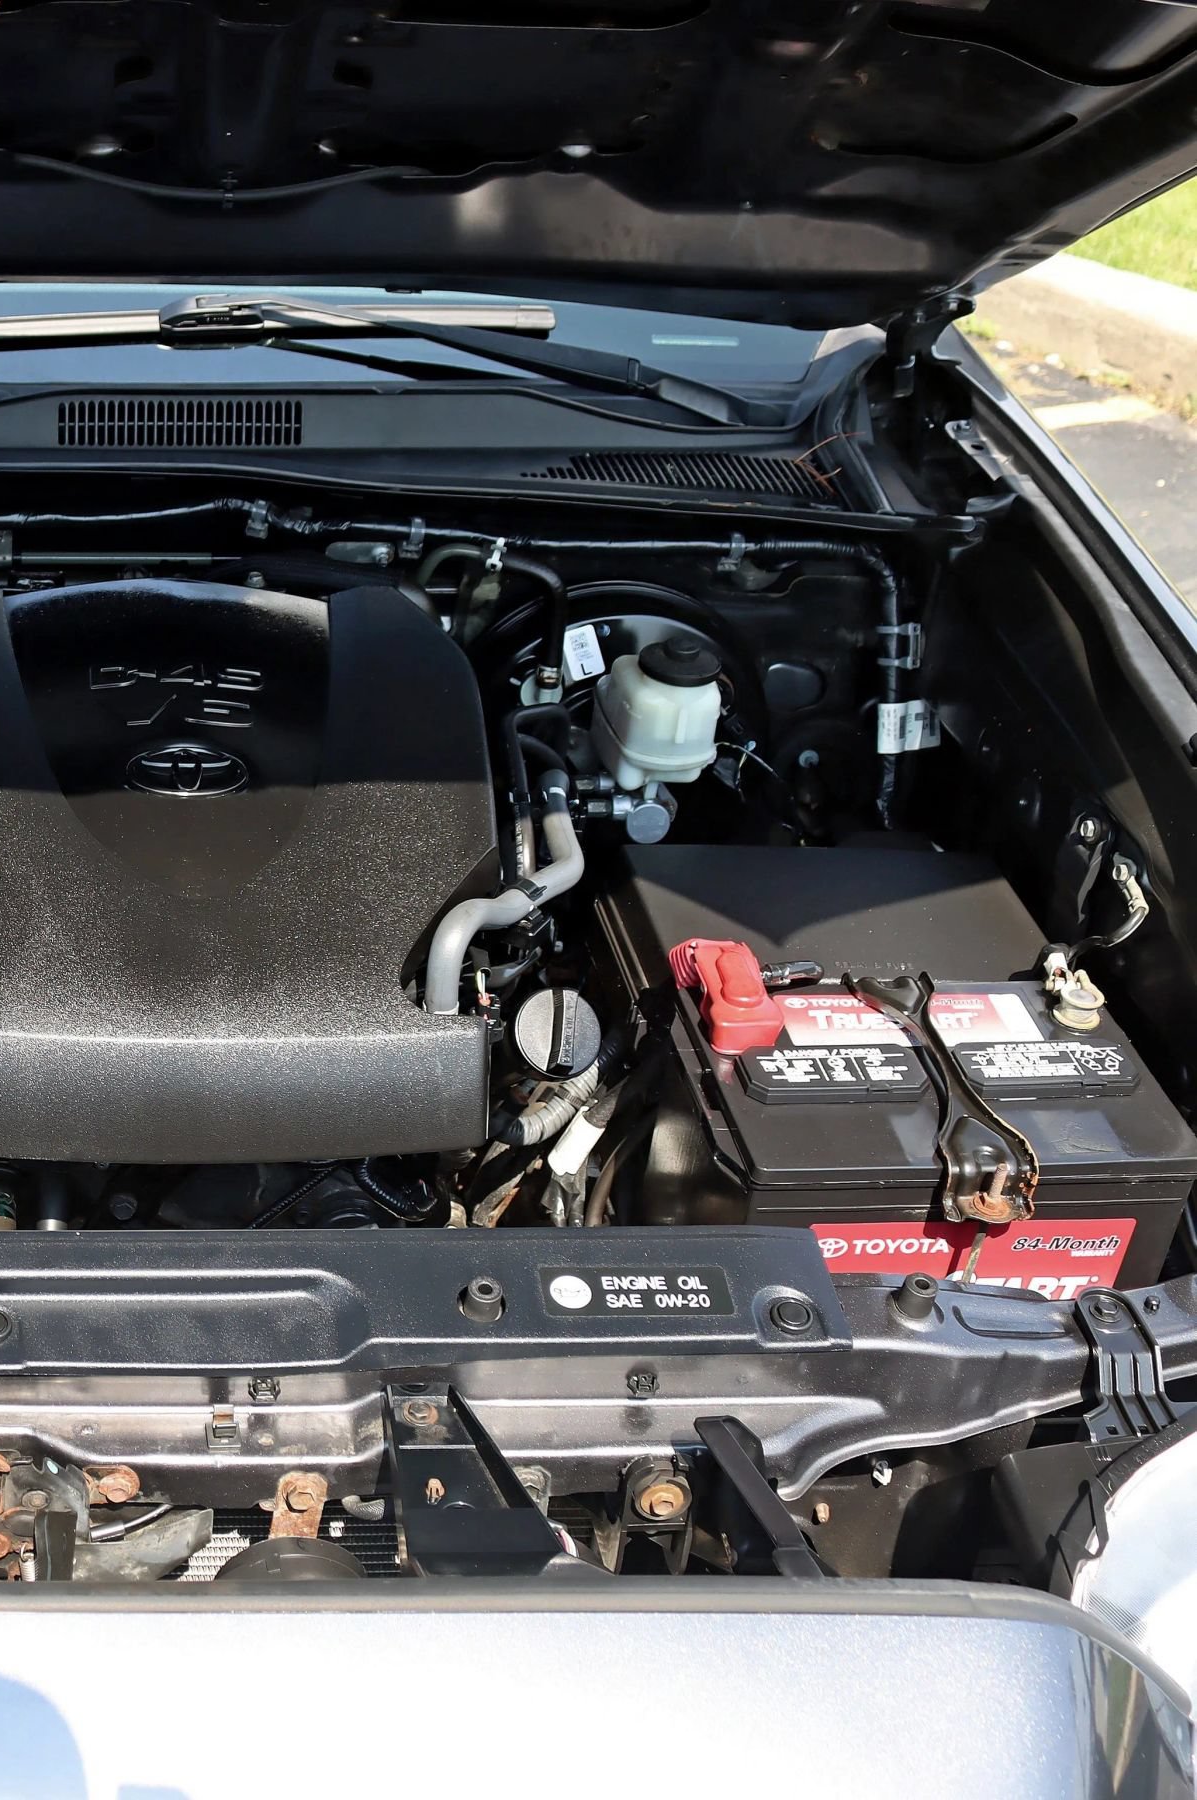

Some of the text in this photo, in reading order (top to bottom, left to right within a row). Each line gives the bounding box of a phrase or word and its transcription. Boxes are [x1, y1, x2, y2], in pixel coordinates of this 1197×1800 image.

[853, 1235, 1120, 1254] TOYOTA 84-Month
[601, 1276, 708, 1290] ENGINE OIL
[606, 1293, 711, 1308] SAE 0W-20
